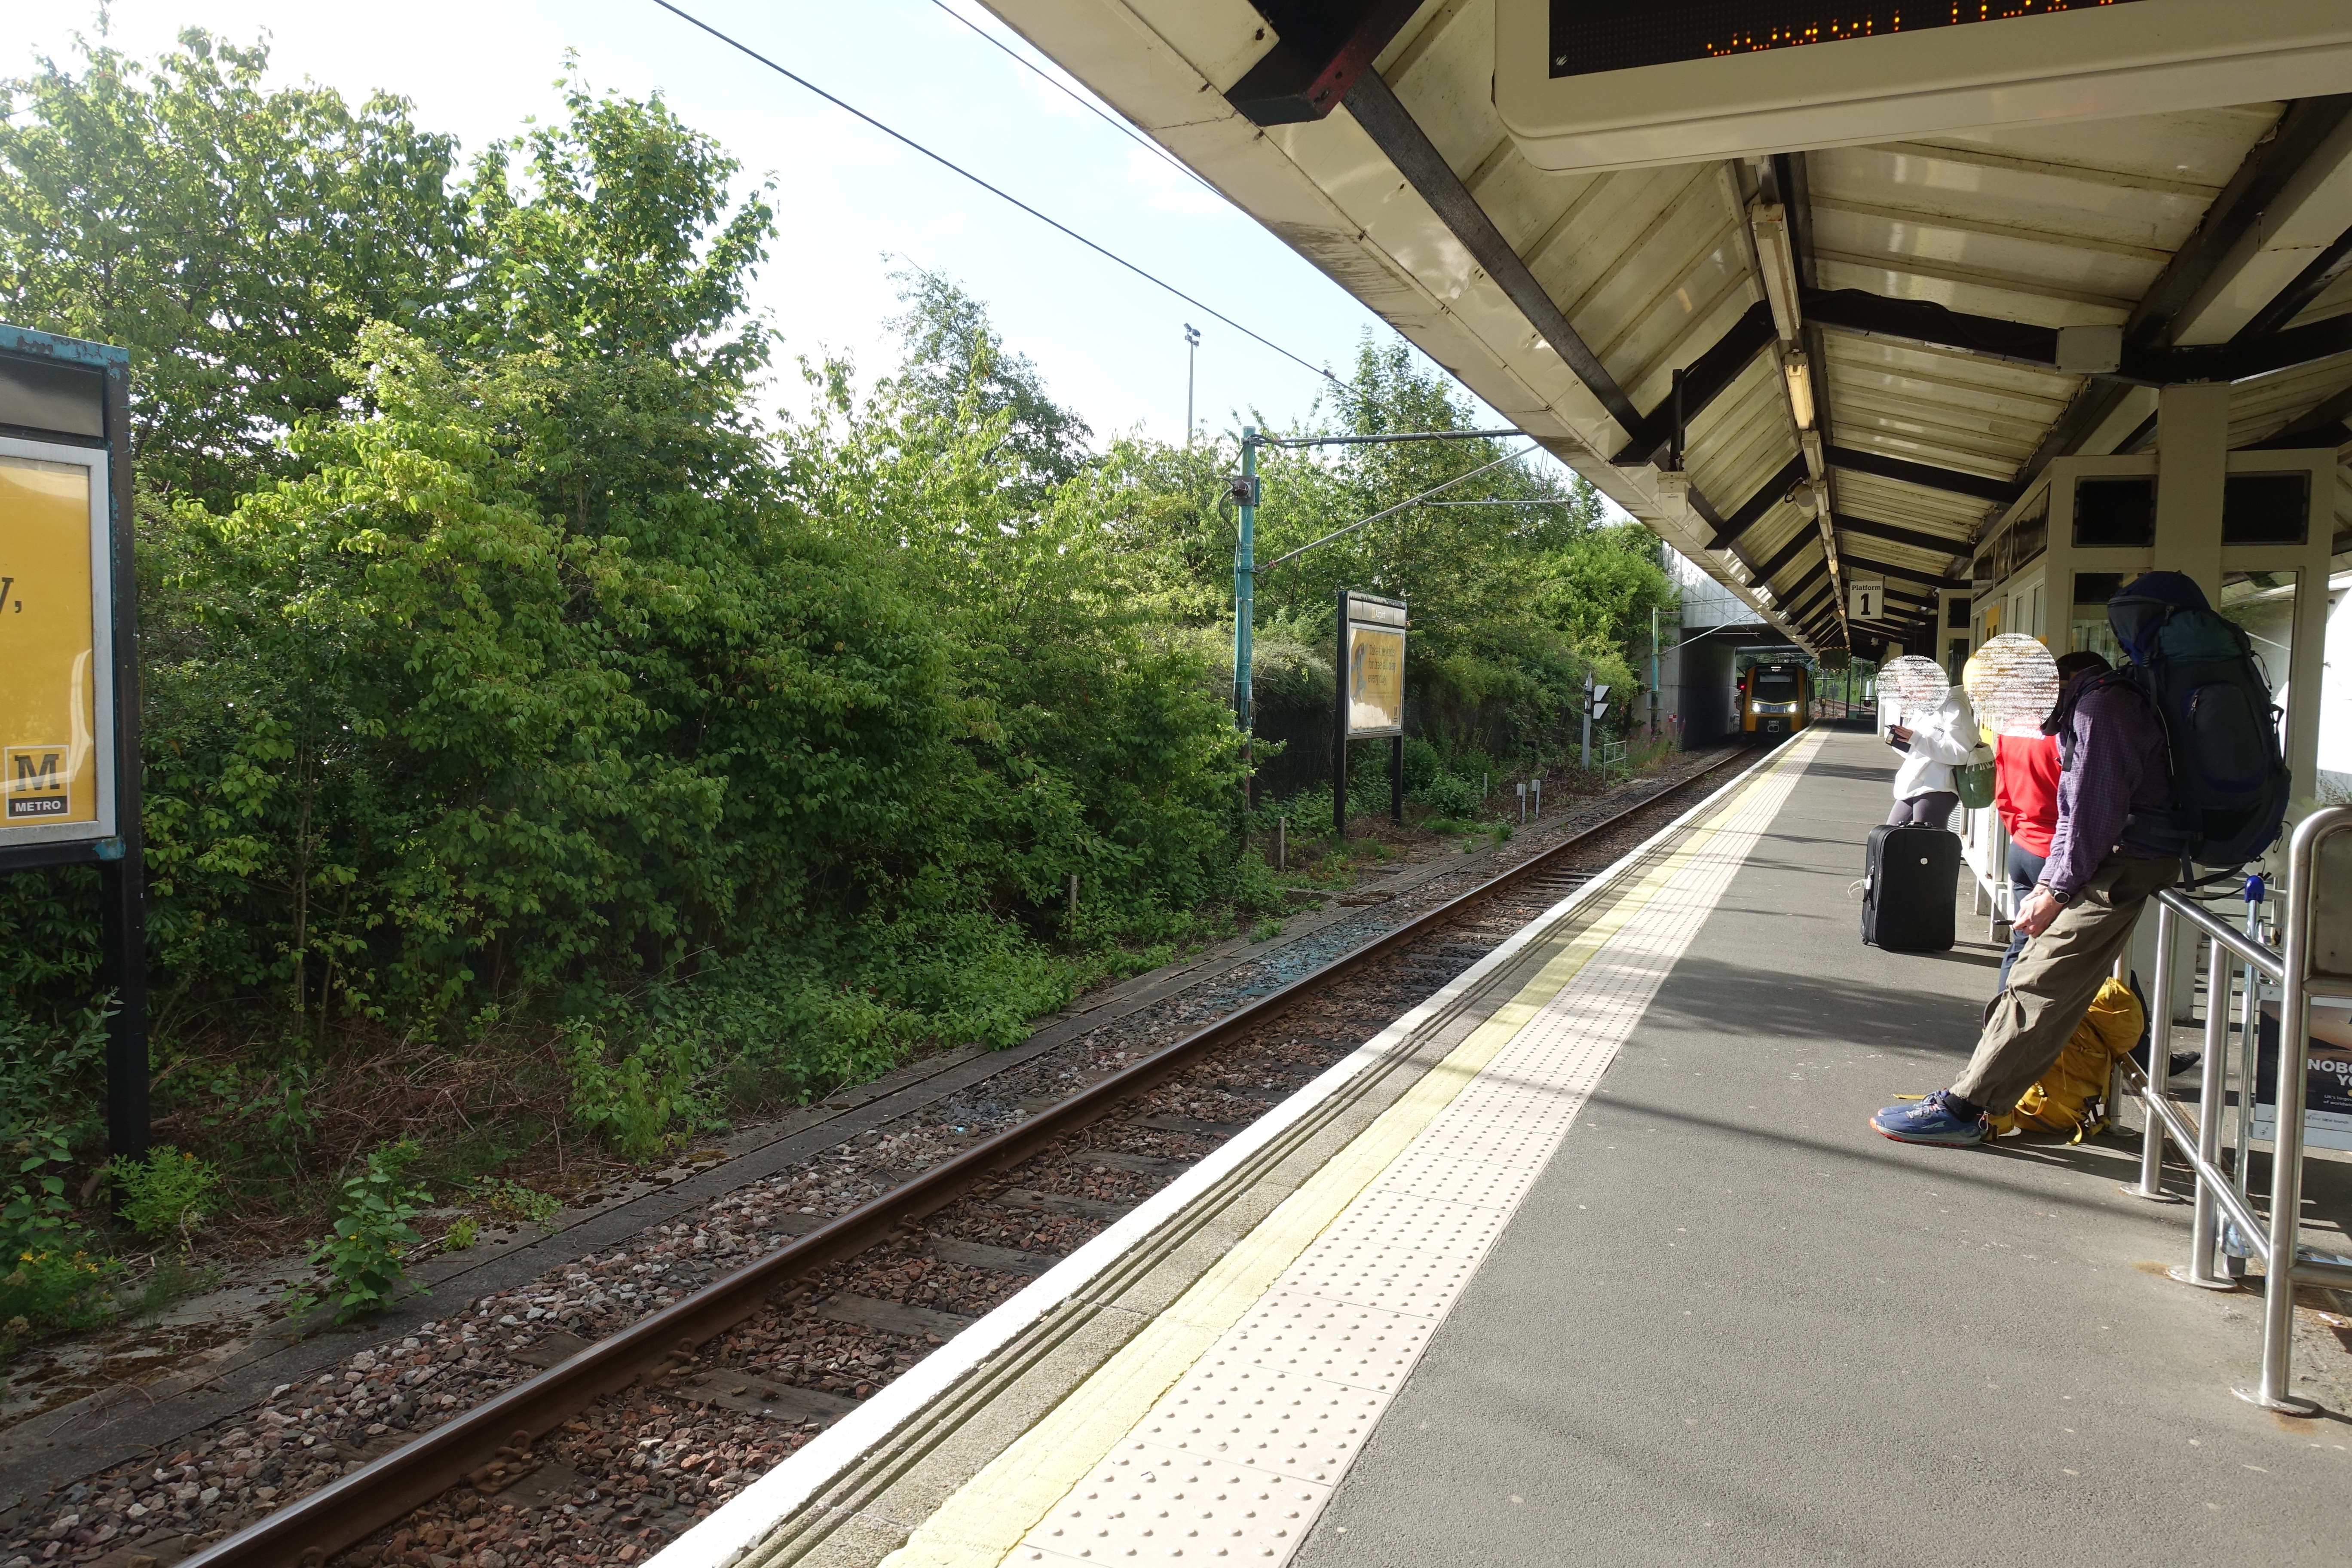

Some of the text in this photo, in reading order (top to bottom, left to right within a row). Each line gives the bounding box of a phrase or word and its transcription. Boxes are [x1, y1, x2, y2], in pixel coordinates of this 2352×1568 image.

[1861, 593, 1871, 615] 1
[1375, 609, 1385, 619] Airport
[1369, 645, 1378, 655] Take
[1387, 646, 1395, 657] kids
[1368, 674, 1378, 685] every
[14, 754, 60, 791] M
[15, 800, 61, 812] METRO
[2308, 1059, 2352, 1074] NOB
[2337, 1074, 2352, 1086] Y
